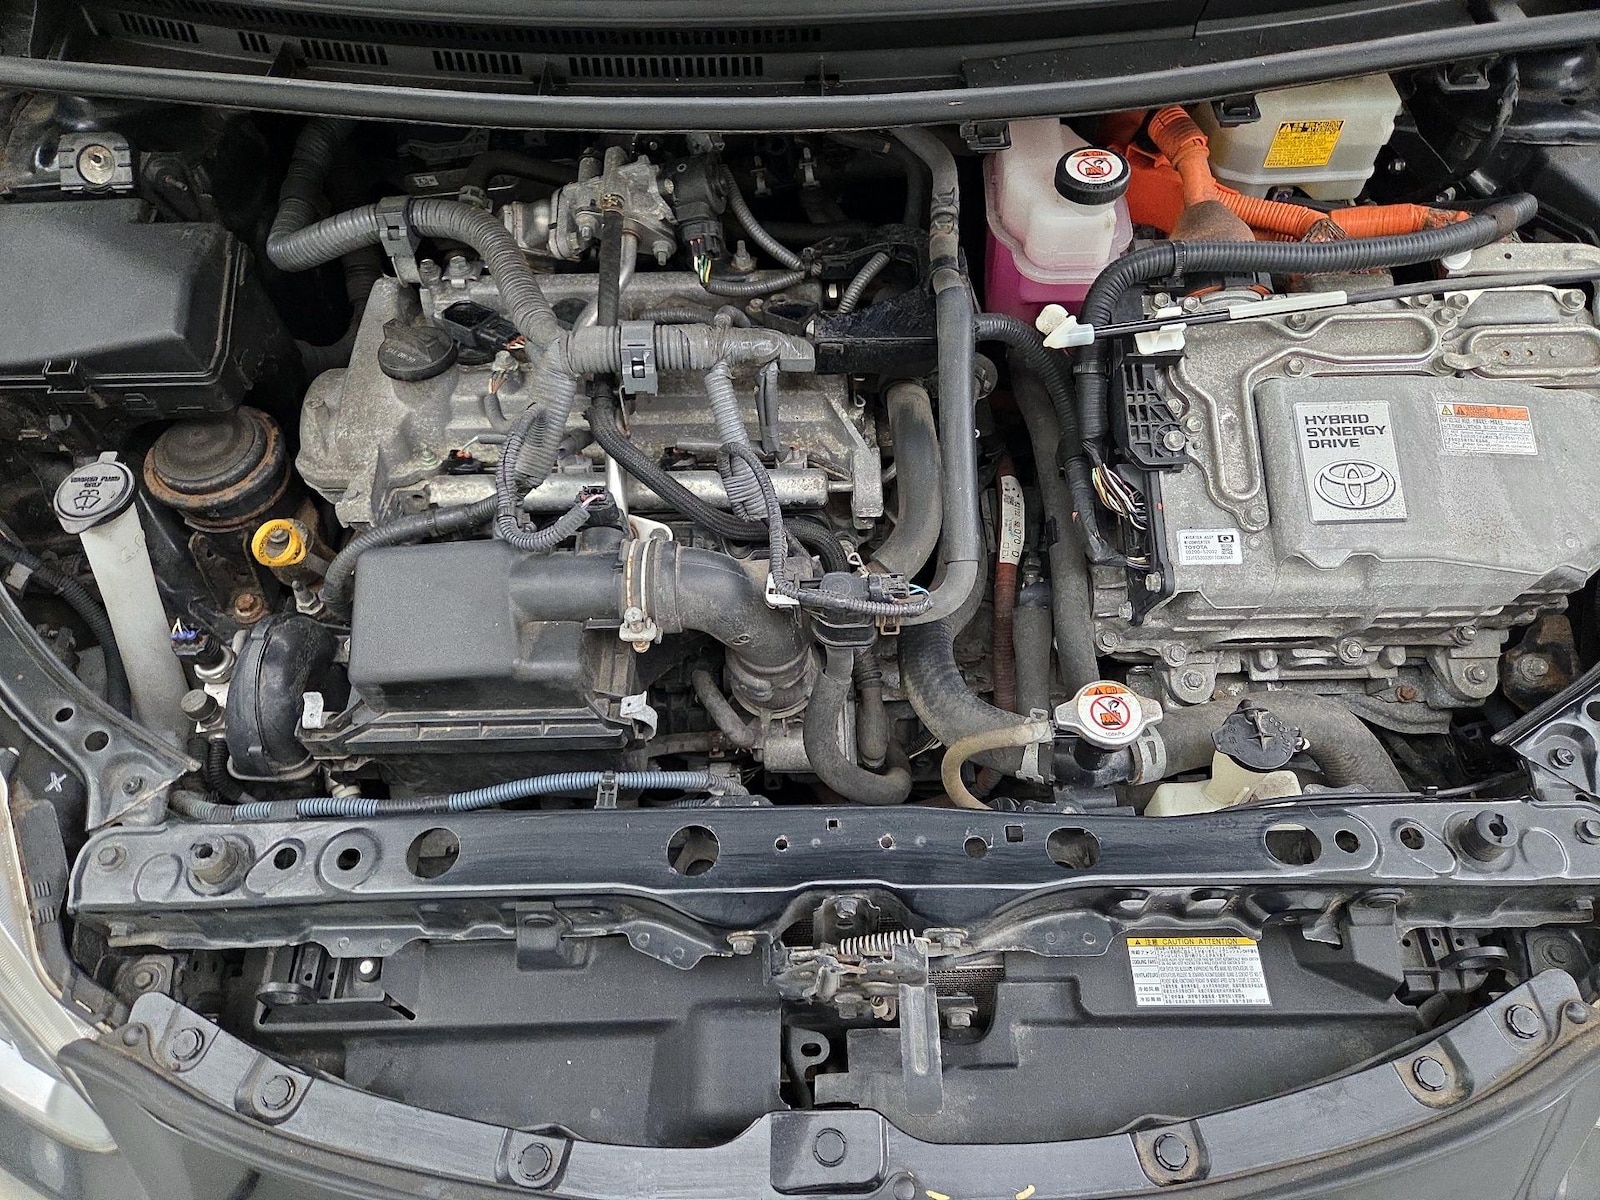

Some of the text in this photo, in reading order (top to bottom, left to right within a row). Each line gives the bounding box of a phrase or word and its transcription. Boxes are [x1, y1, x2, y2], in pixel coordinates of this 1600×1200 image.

[1305, 414, 1369, 425] HYBRID
[1306, 425, 1386, 437] SYNERGY
[1308, 438, 1360, 449] DRIVE
